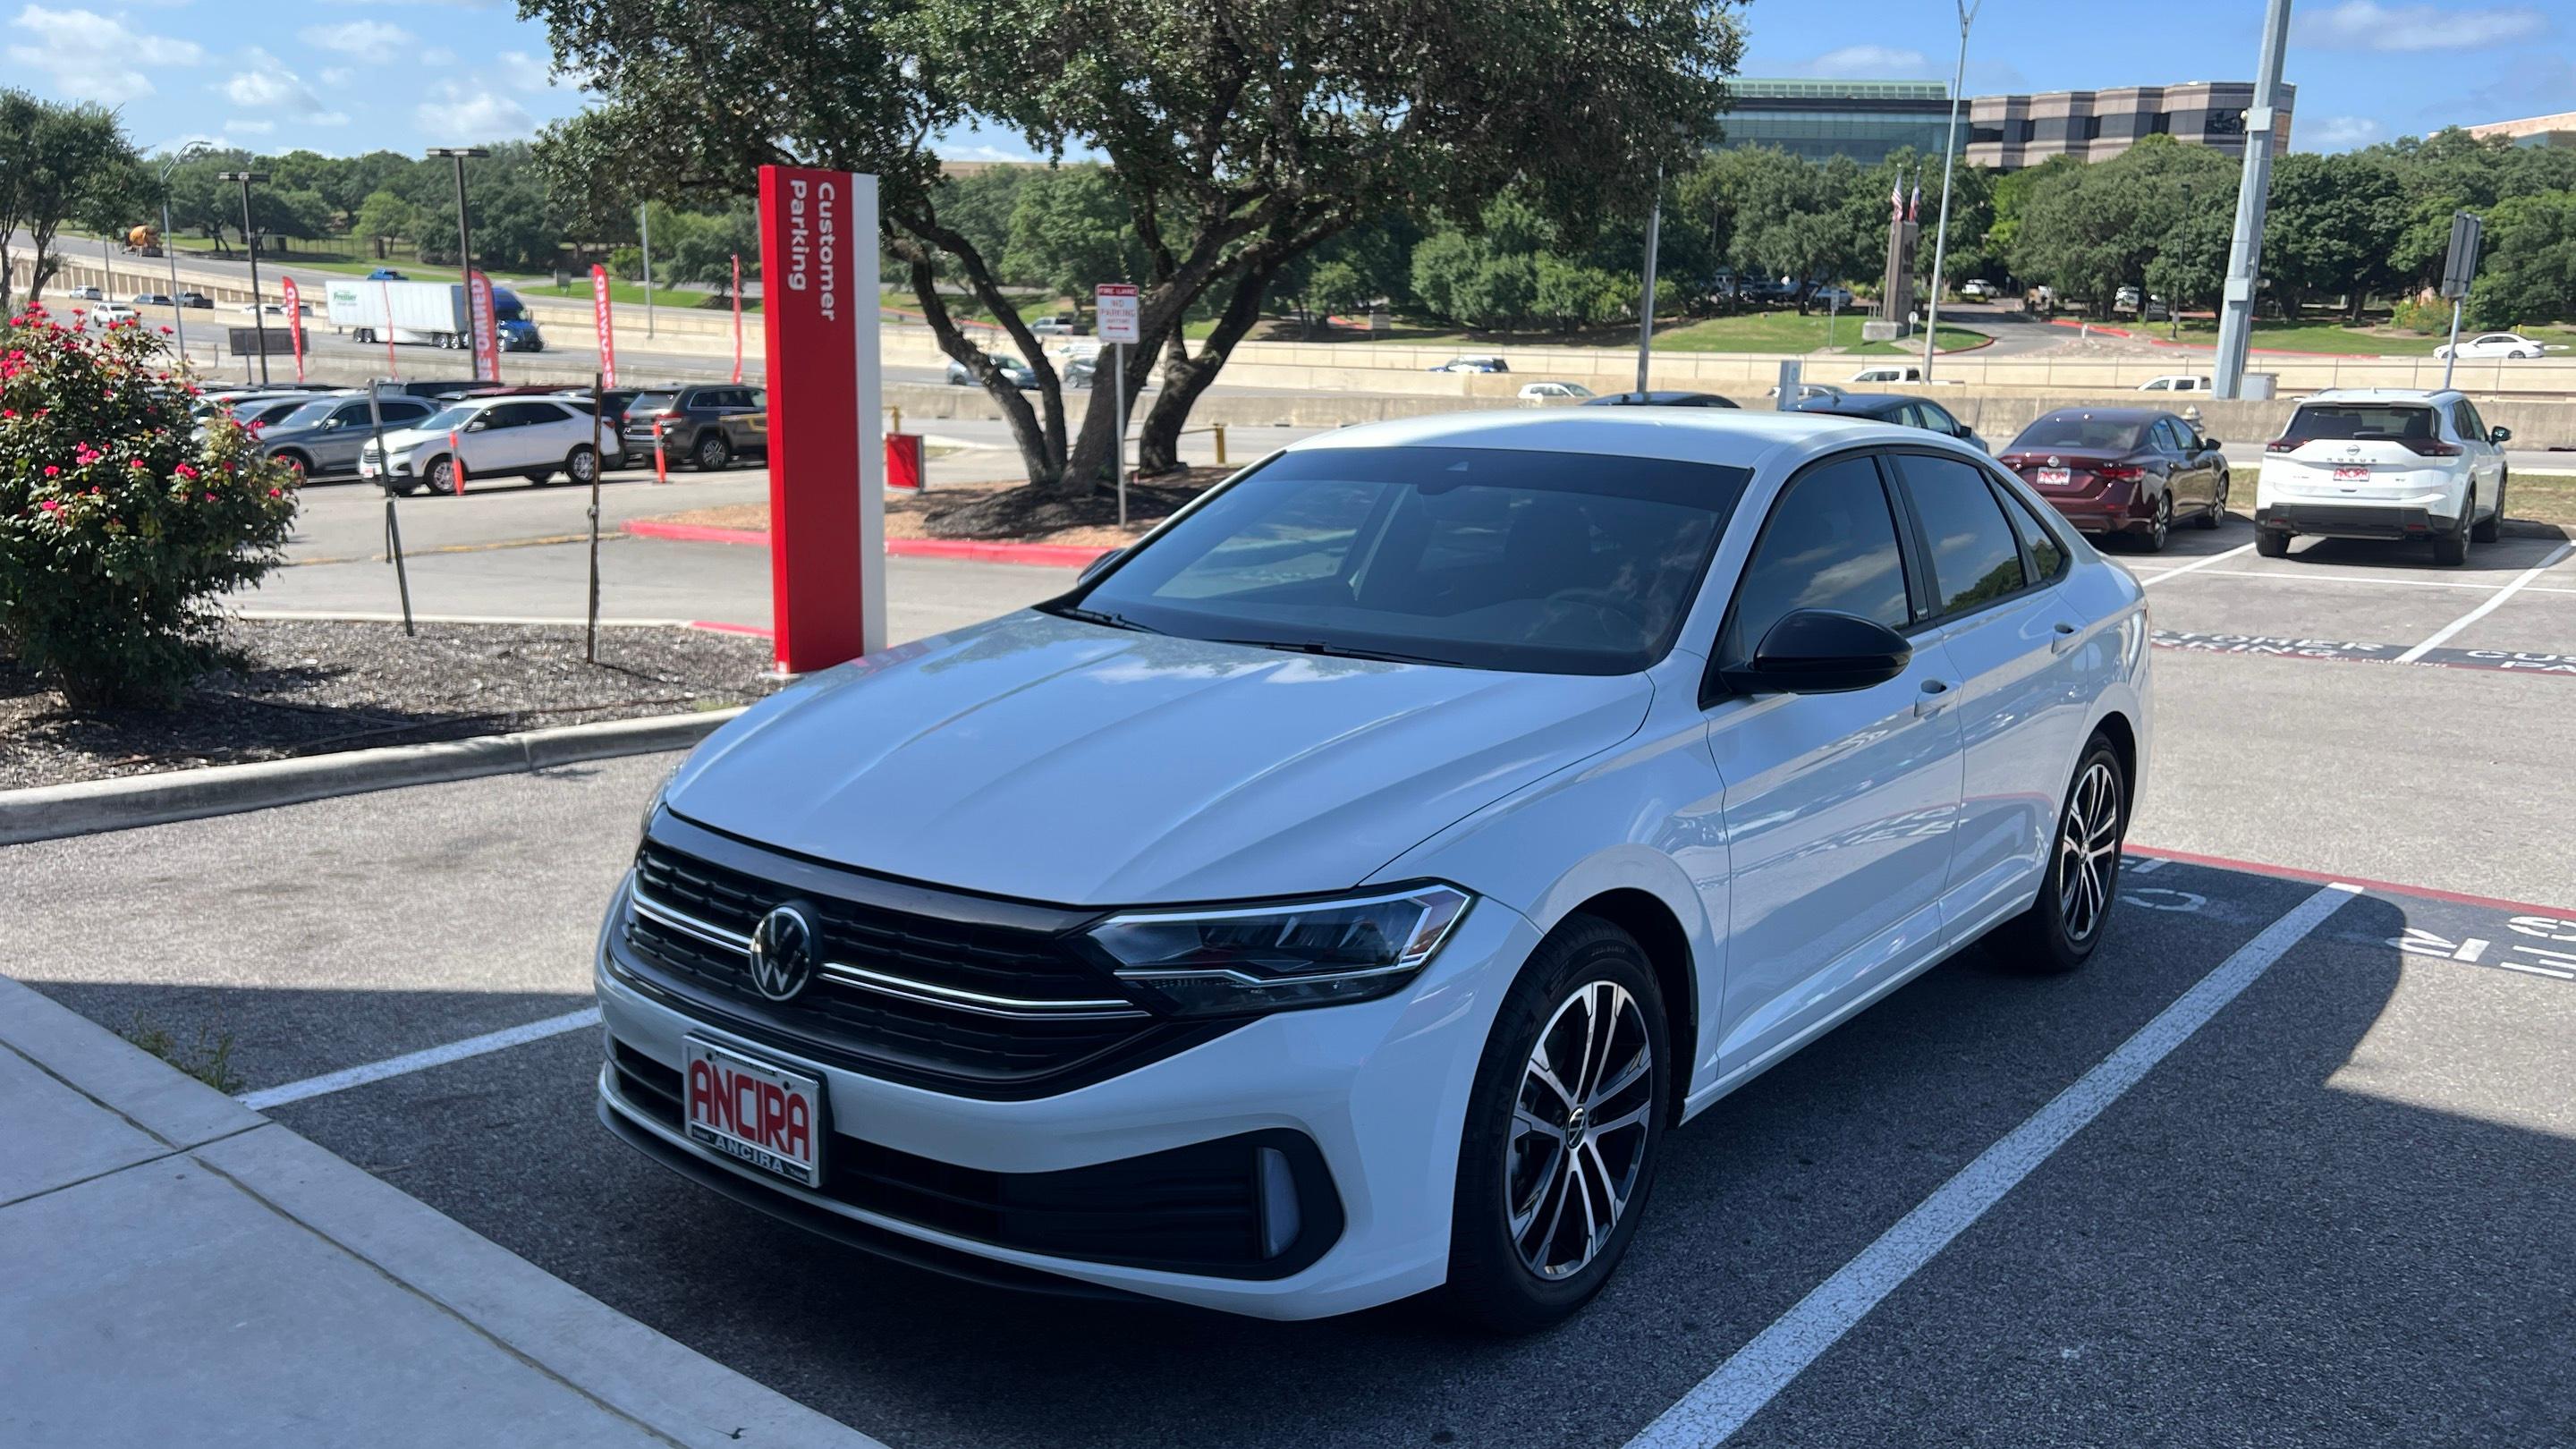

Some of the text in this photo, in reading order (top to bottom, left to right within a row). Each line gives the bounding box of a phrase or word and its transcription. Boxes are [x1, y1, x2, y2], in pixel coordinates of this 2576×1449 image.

[788, 179, 810, 292] Parking
[818, 182, 835, 322] Customer
[1101, 308, 1136, 318] PARKING
[1111, 300, 1124, 308] NO
[691, 1059, 810, 1162] ANCIRA
[716, 1136, 784, 1174] ANCIRA
